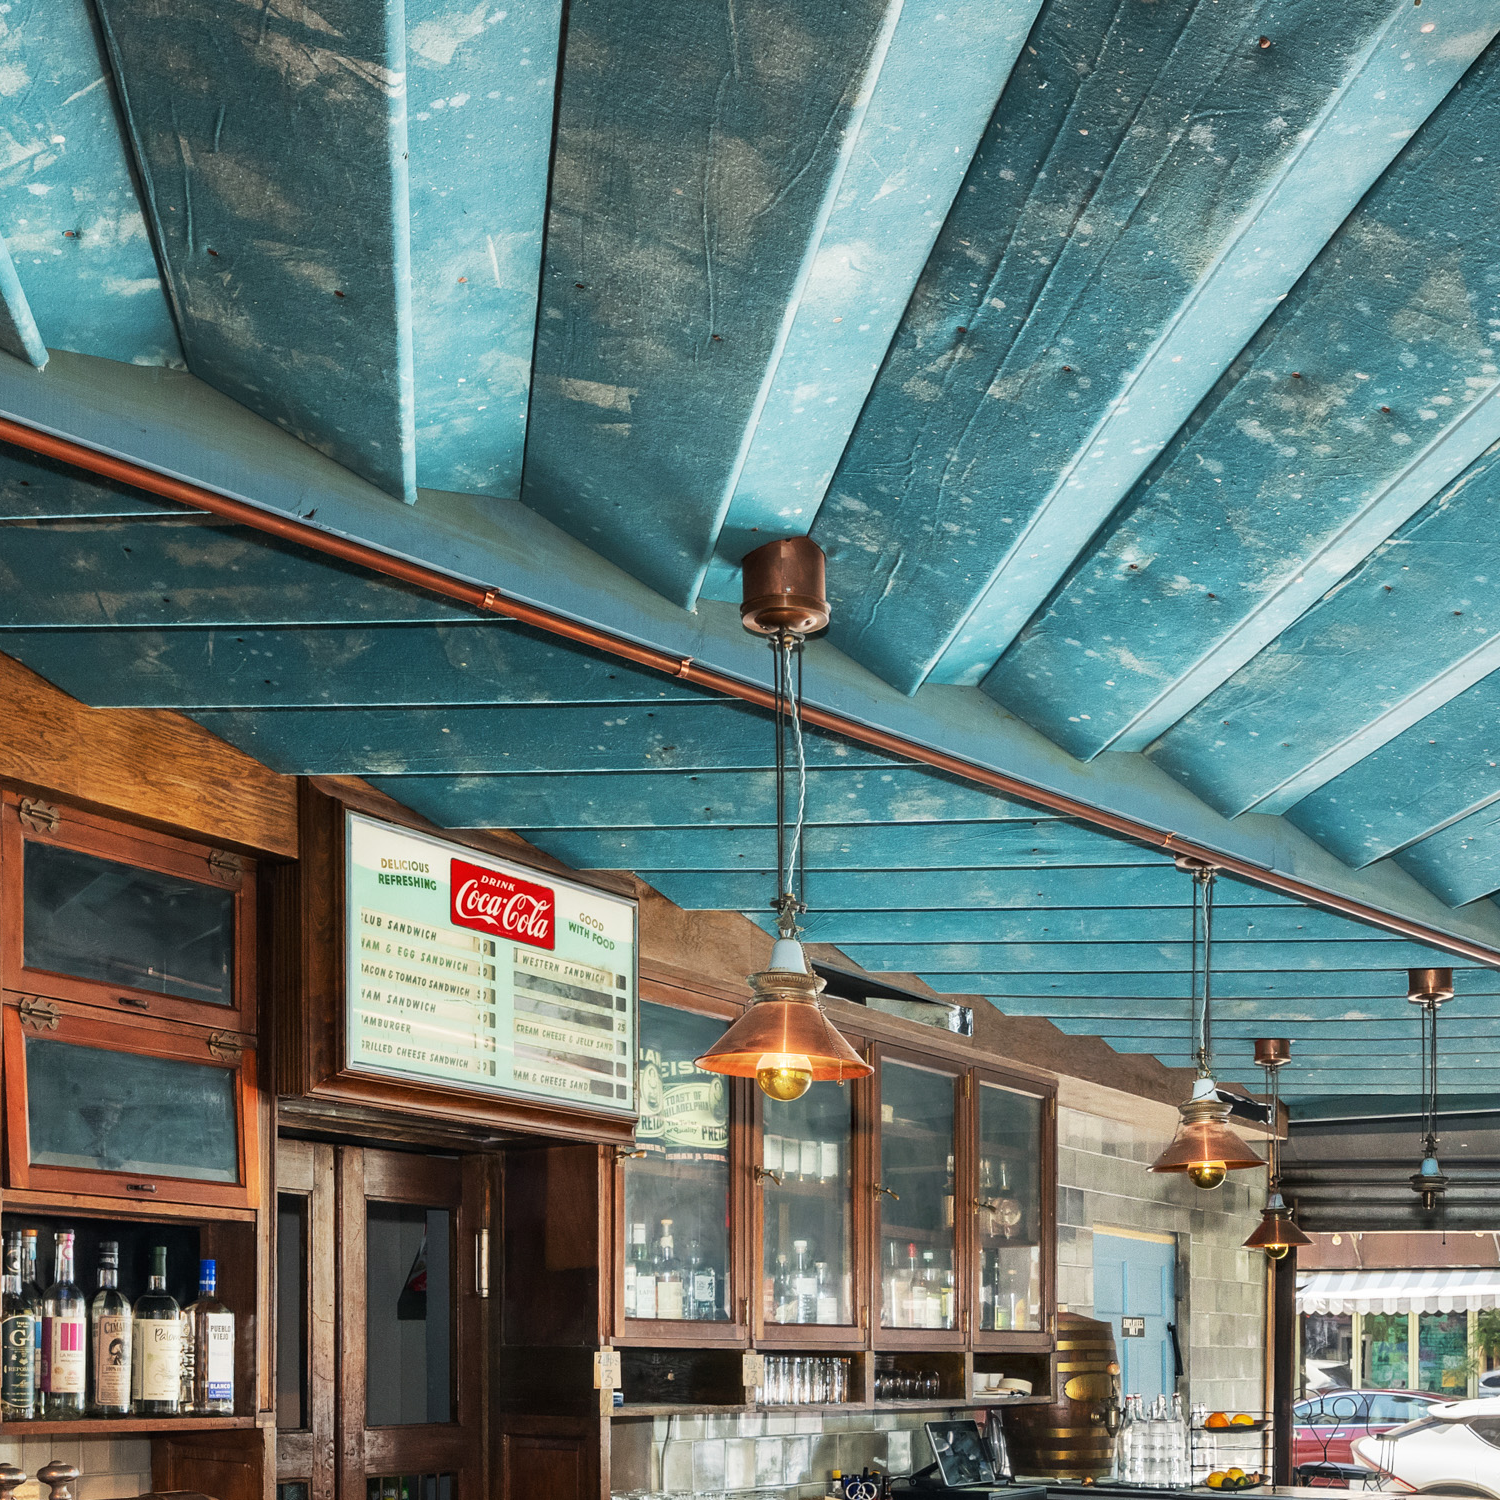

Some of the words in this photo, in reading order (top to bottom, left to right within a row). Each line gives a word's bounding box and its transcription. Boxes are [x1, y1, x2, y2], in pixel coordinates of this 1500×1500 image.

[380, 857, 430, 874] DELICIOUS
[378, 872, 437, 891] REFRESHING
[480, 874, 516, 892] DRINK
[455, 879, 552, 939] Coca-Cola
[387, 920, 437, 941] SANDWICH
[579, 912, 605, 932] GOOD
[568, 921, 590, 939] WITH
[592, 933, 615, 951] FOOD
[385, 943, 391, 954] &
[397, 946, 415, 959] EGG
[420, 952, 469, 973] SANDWICH
[522, 955, 560, 972] WESTERN
[563, 966, 606, 984] SANDWICH
[387, 970, 393, 979] &
[395, 971, 427, 987] TOMATO
[428, 979, 470, 997] SANDWICH
[386, 994, 437, 1013] SANDWICH
[361, 1015, 411, 1034] AMBURGER
[516, 1023, 540, 1036] CREAM
[542, 1029, 566, 1042] CHEESE
[576, 1037, 594, 1049] JELLY
[596, 1040, 613, 1052] SAND
[396, 1046, 426, 1061] CHEESE
[429, 1053, 469, 1069] SANDWICH
[532, 1074, 537, 1082] &
[540, 1074, 567, 1087] CHEESE
[665, 1091, 690, 1107] TOAST
[693, 1090, 702, 1101] OF
[9, 1329, 35, 1347] G4
[210, 1325, 231, 1333] PUEBLO
[212, 1332, 229, 1340] VIEJO
